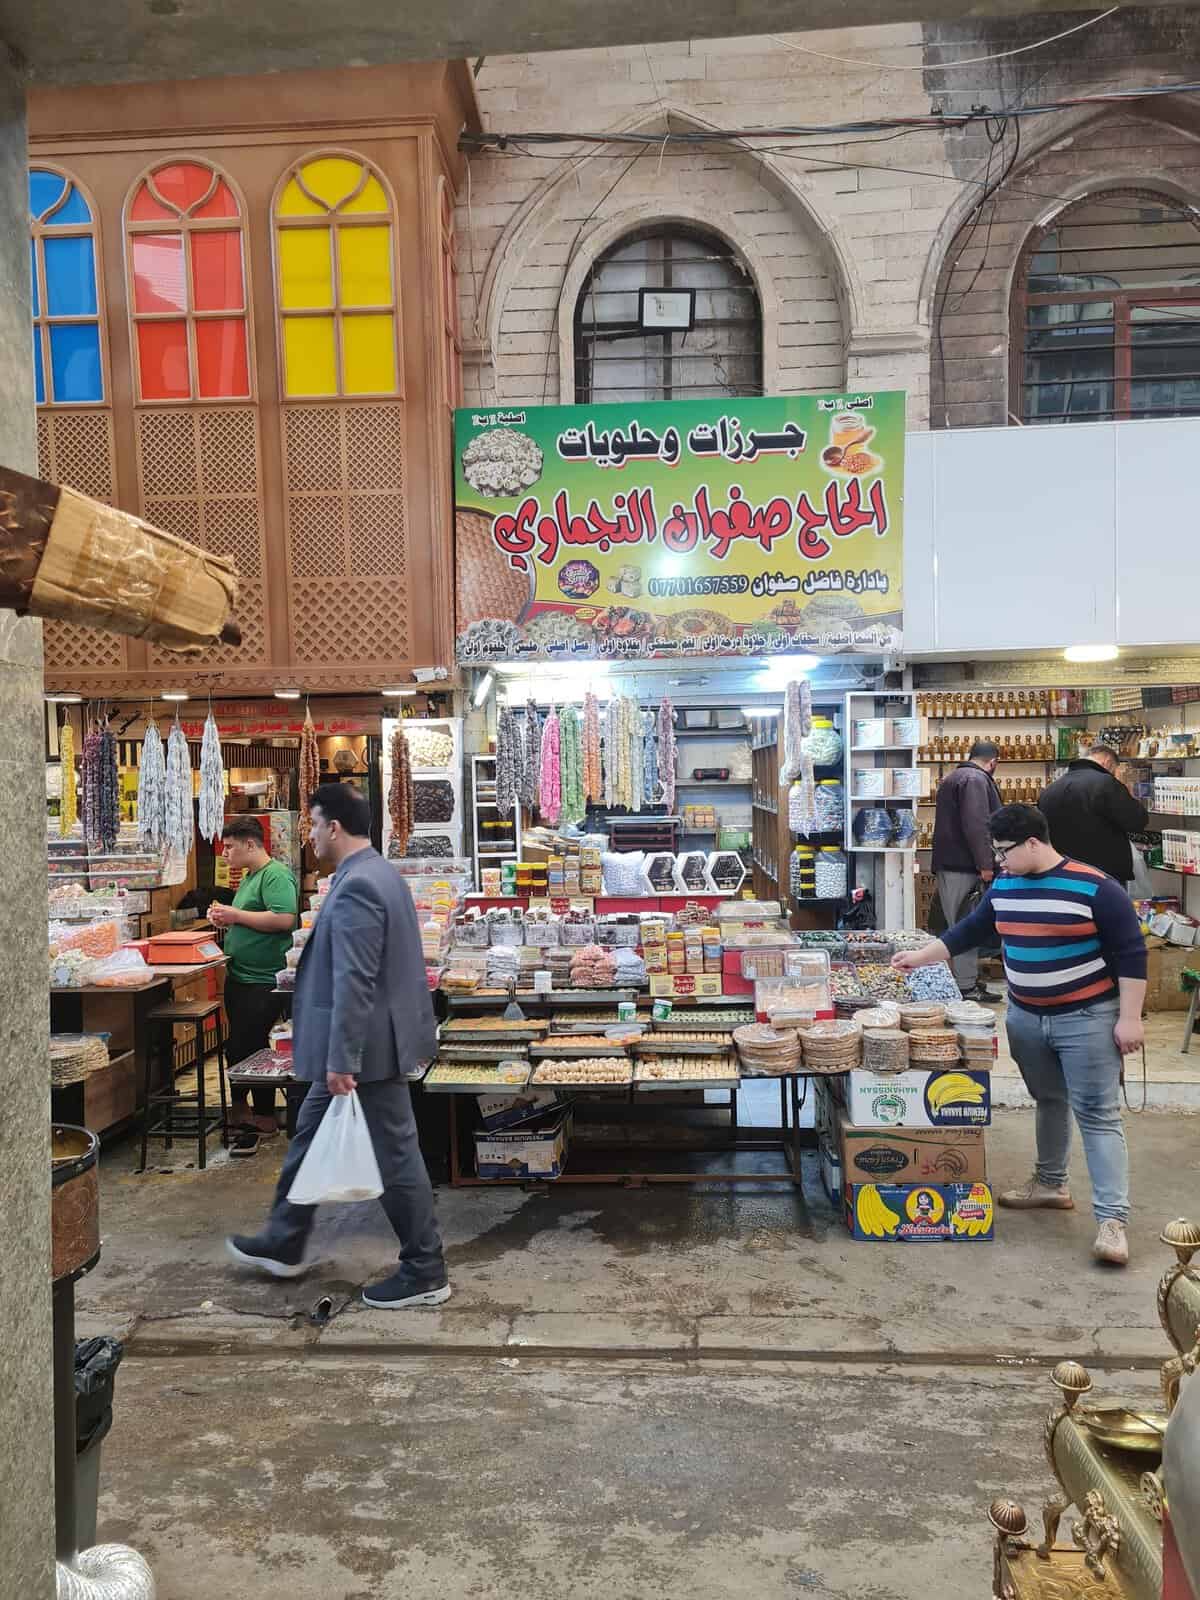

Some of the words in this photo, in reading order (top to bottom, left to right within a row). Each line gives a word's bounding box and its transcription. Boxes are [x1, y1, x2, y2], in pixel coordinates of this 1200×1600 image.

[557, 420, 680, 466] وحلويات
[688, 416, 807, 463] جرزات
[493, 486, 657, 572] النجماوي
[662, 485, 793, 560] صفوان
[797, 477, 888, 560] الحاج
[648, 575, 749, 598] 07701657559
[751, 573, 800, 598] صفوان
[801, 570, 843, 597] فاضل
